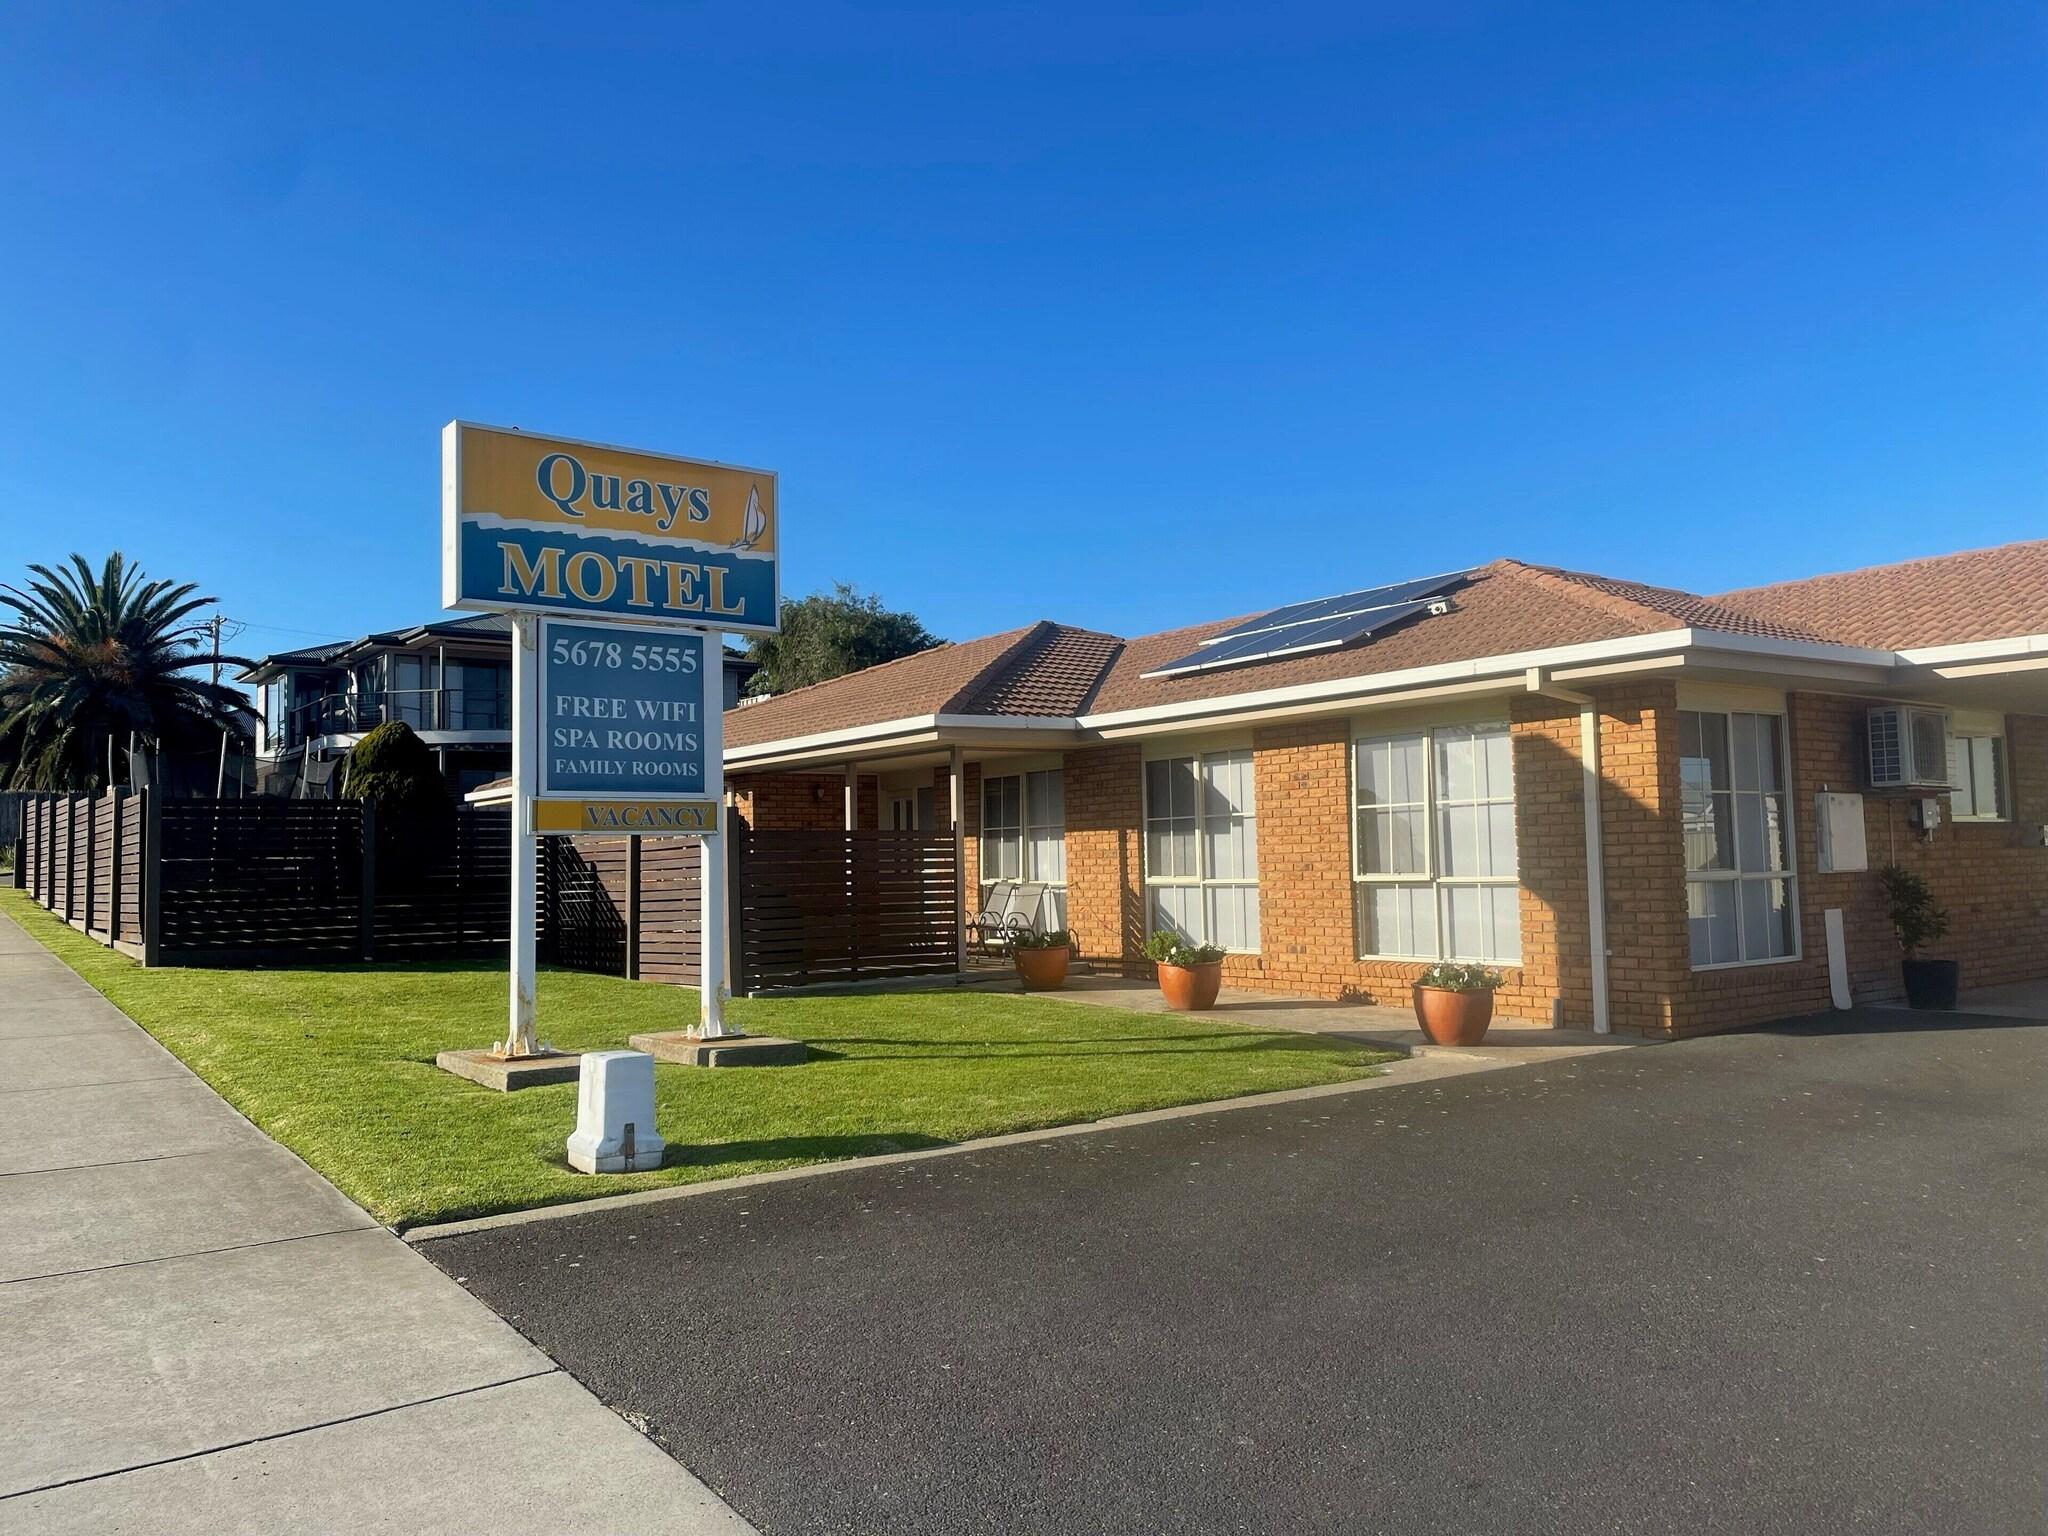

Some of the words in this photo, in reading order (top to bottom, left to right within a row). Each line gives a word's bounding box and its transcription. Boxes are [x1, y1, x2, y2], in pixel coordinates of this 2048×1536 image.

[536, 453, 710, 530] Quays
[497, 541, 746, 616] MOTEL
[552, 639, 622, 670] 5678
[631, 643, 698, 674] 5555
[555, 695, 628, 719] FREE
[635, 701, 697, 722] WIFI
[553, 728, 599, 749] SPA
[608, 731, 698, 752] ROOMS
[555, 759, 627, 775] FAMILY
[632, 761, 698, 777] ROOMS
[587, 805, 709, 826] VACANCY
